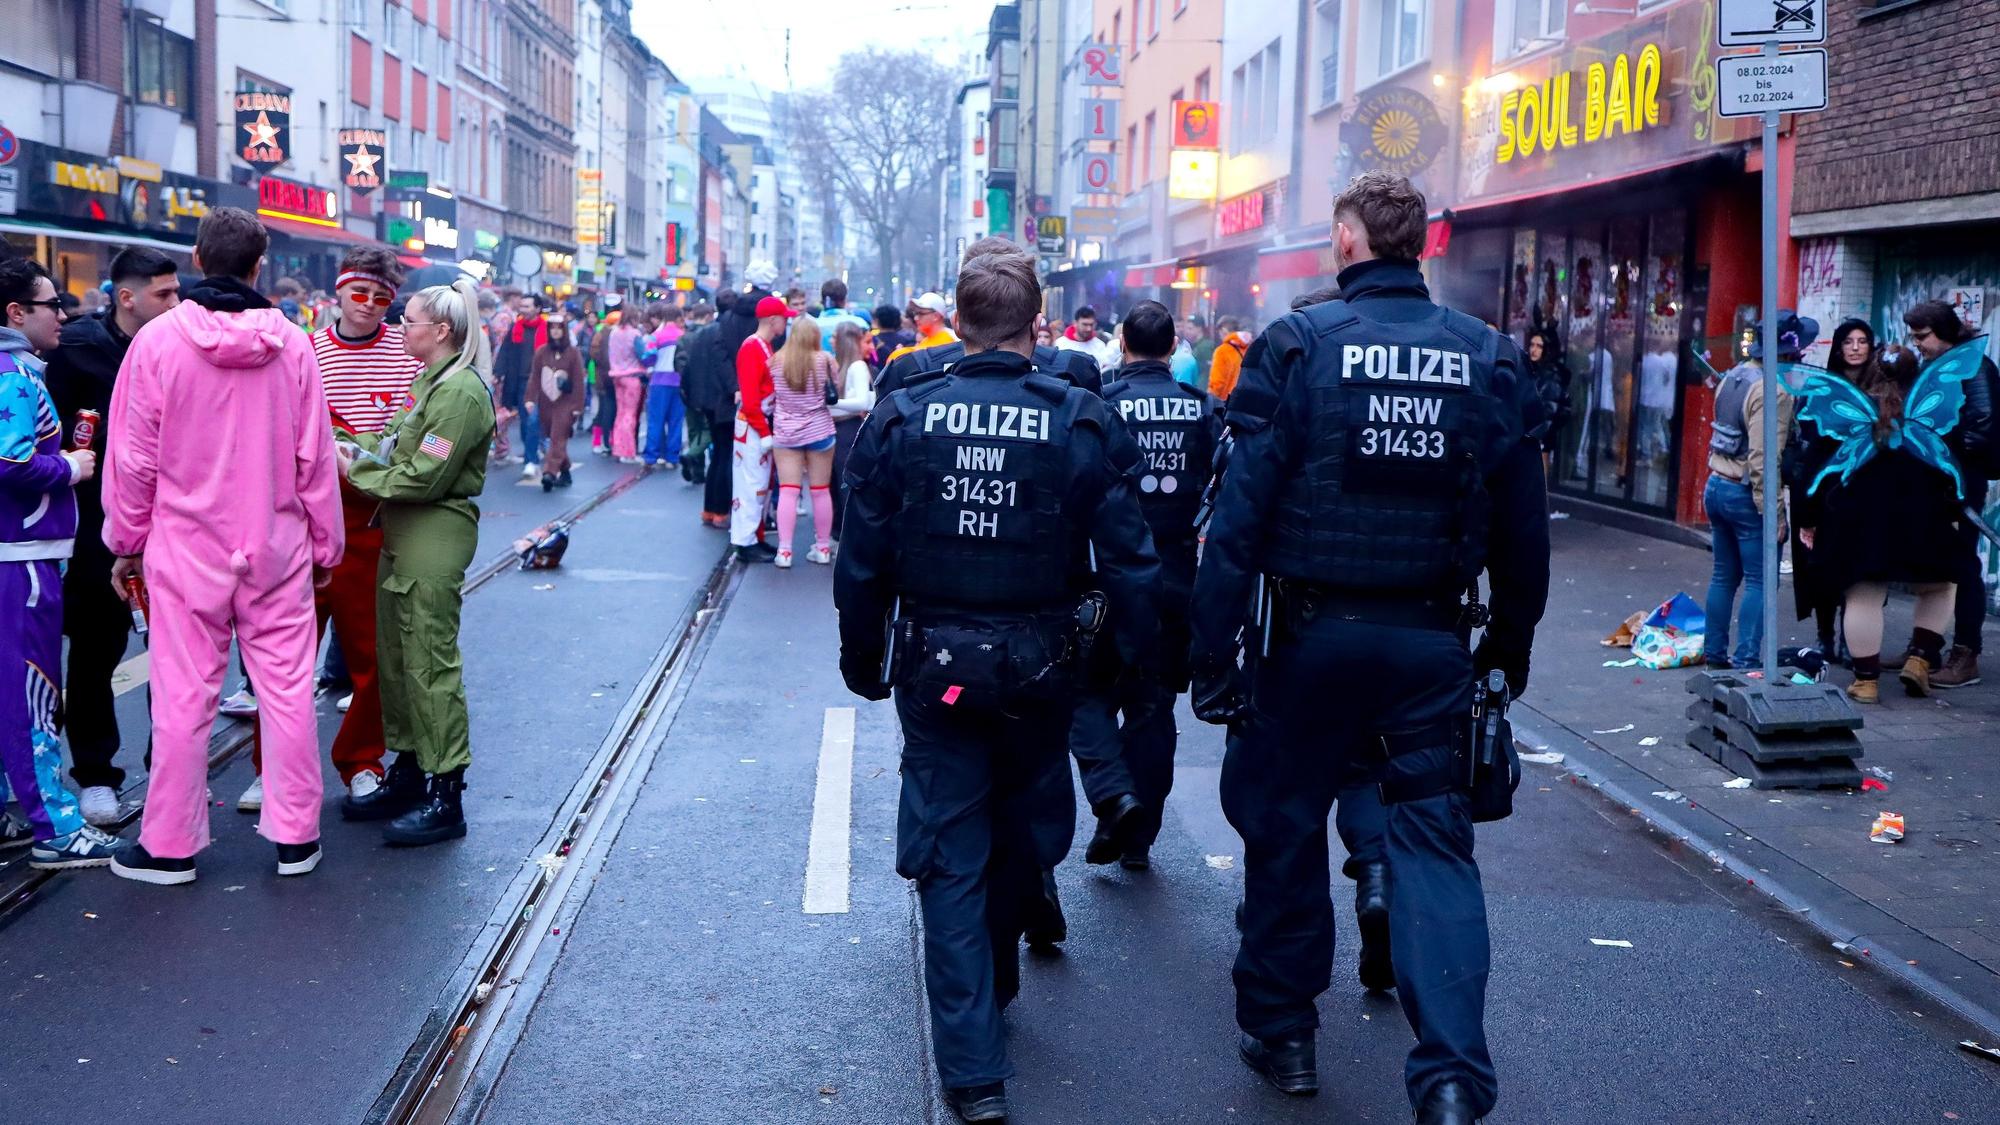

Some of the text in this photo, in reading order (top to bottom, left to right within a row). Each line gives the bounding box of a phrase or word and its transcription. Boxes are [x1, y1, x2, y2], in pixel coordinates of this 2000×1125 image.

[1737, 65, 1794, 77] 08.02.2024
[1756, 80, 1772, 89] bis
[1496, 70, 1578, 164] SOUL
[1584, 42, 1661, 143] BAR
[1738, 91, 1794, 103] 12.02.2024
[243, 146, 283, 162] BAR
[1342, 344, 1471, 386] POLIZEI
[924, 402, 1050, 440] POLIZEI
[1368, 394, 1443, 425] NRW
[1137, 431, 1185, 449] NRW
[1360, 427, 1445, 458] 31433
[956, 445, 1006, 472] NRW
[1143, 452, 1187, 471] 1431
[941, 475, 1017, 507] 31431
[958, 509, 998, 538] RH
[69, 836, 98, 856] N
